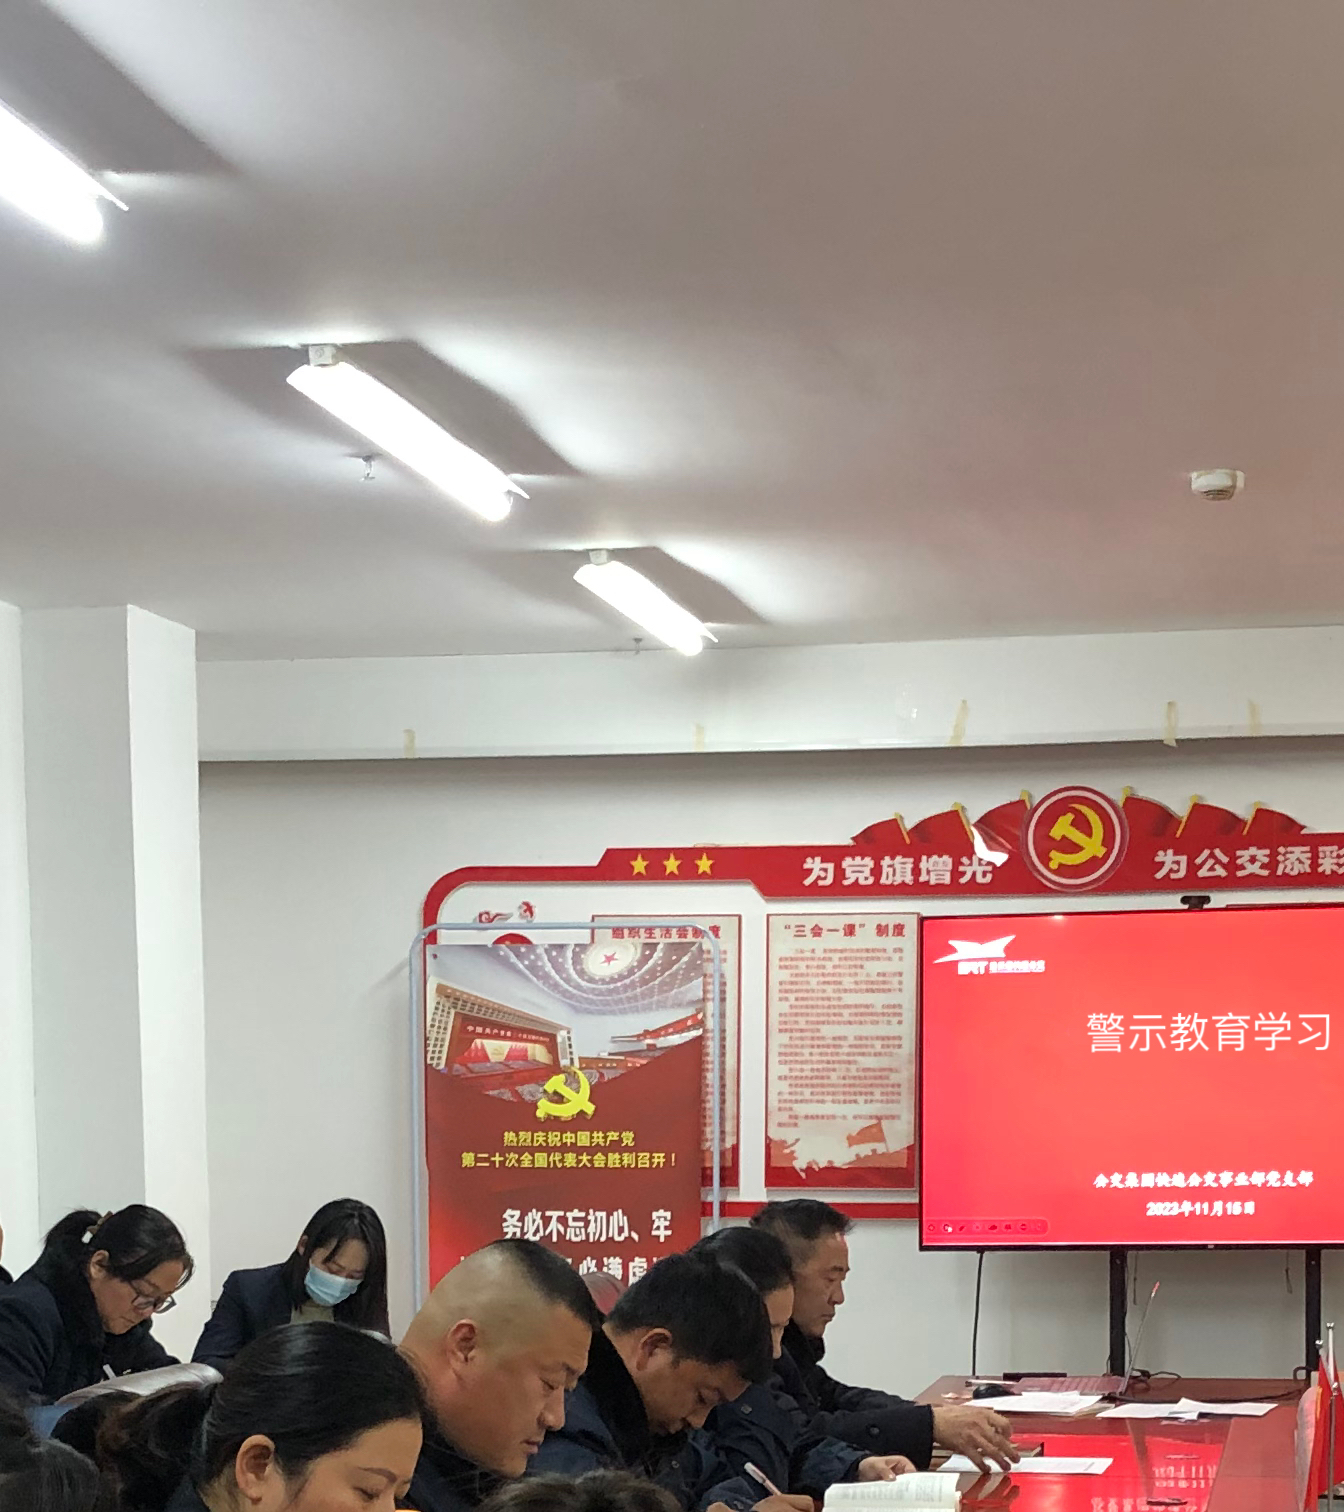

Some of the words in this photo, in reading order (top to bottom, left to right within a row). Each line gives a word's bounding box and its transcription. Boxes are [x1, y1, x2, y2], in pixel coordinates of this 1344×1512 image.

[802, 852, 994, 887] 为党旗增光
[875, 923, 906, 938] 制度
[1086, 1011, 1332, 1054] 警示教育学习
[503, 1131, 635, 1148] 热烈庆祝中国共产党
[461, 1151, 677, 1169] 第二十次全国代表大会胜利召开！
[501, 1208, 673, 1243] 务必不忘初心、牢
